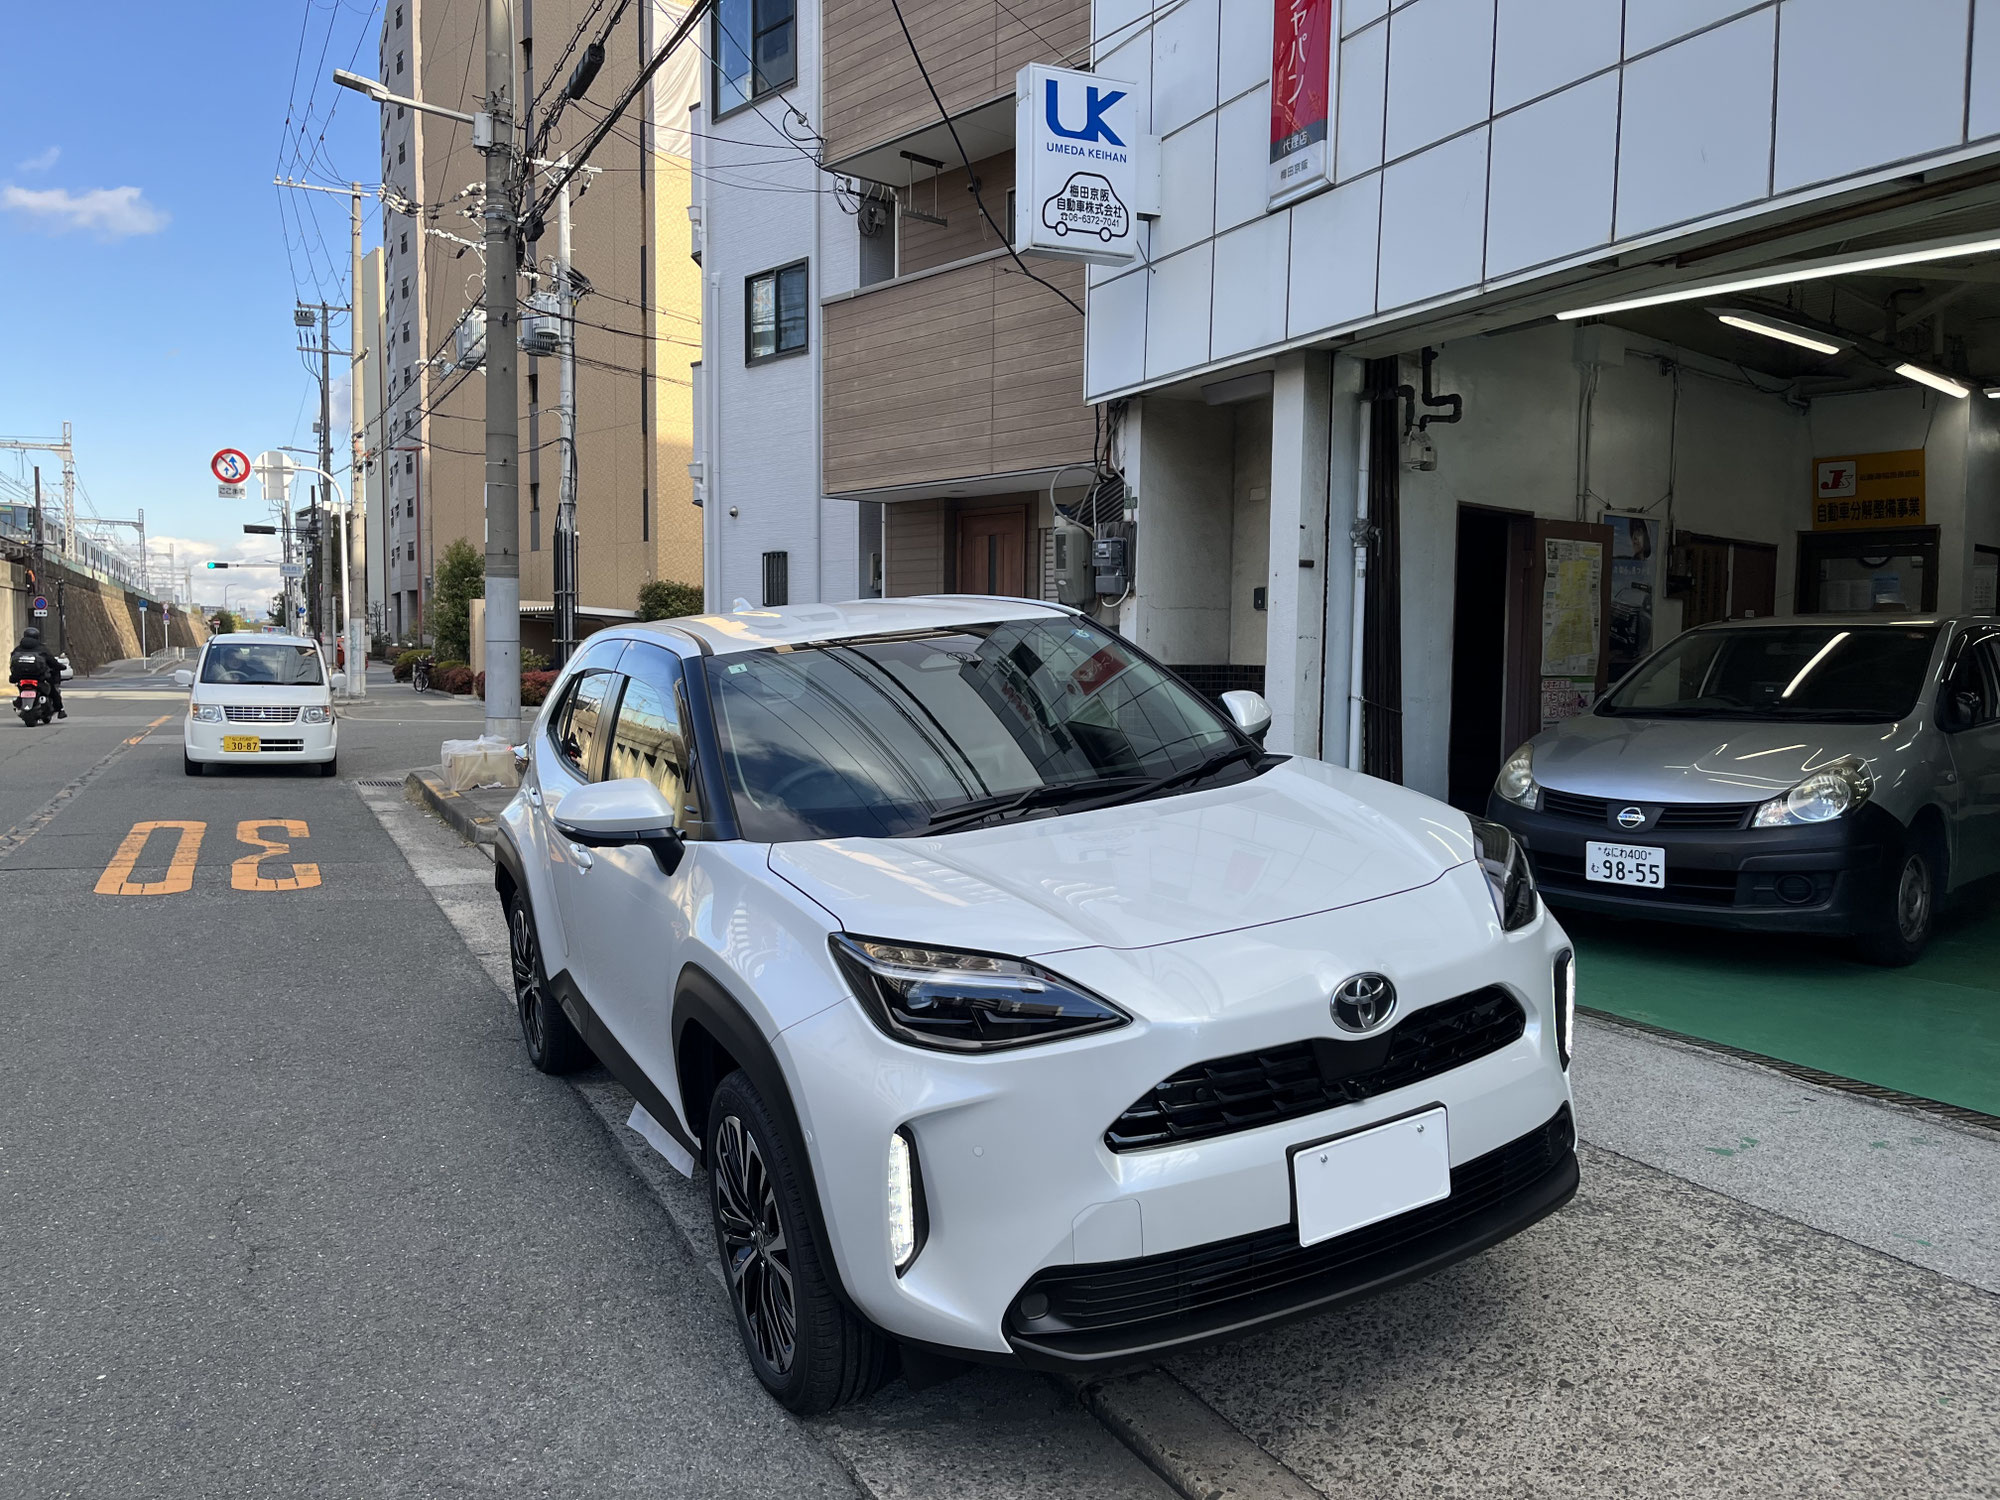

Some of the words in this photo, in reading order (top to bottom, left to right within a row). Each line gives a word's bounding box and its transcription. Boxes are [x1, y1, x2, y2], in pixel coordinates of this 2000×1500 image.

[1046, 79, 1128, 148] UK
[1046, 142, 1085, 157] UMEDA
[1088, 148, 1127, 163] KEIHAN
[1069, 184, 1110, 203] 梅田京阪
[1056, 197, 1123, 219] 自動車株式会社
[1816, 496, 1921, 523] 自動車分解整備事業
[231, 741, 258, 751] 30-87
[93, 819, 322, 895] 30
[1603, 846, 1648, 861] なにわ400
[1590, 862, 1600, 873] む
[1602, 859, 1660, 885] 98-55
